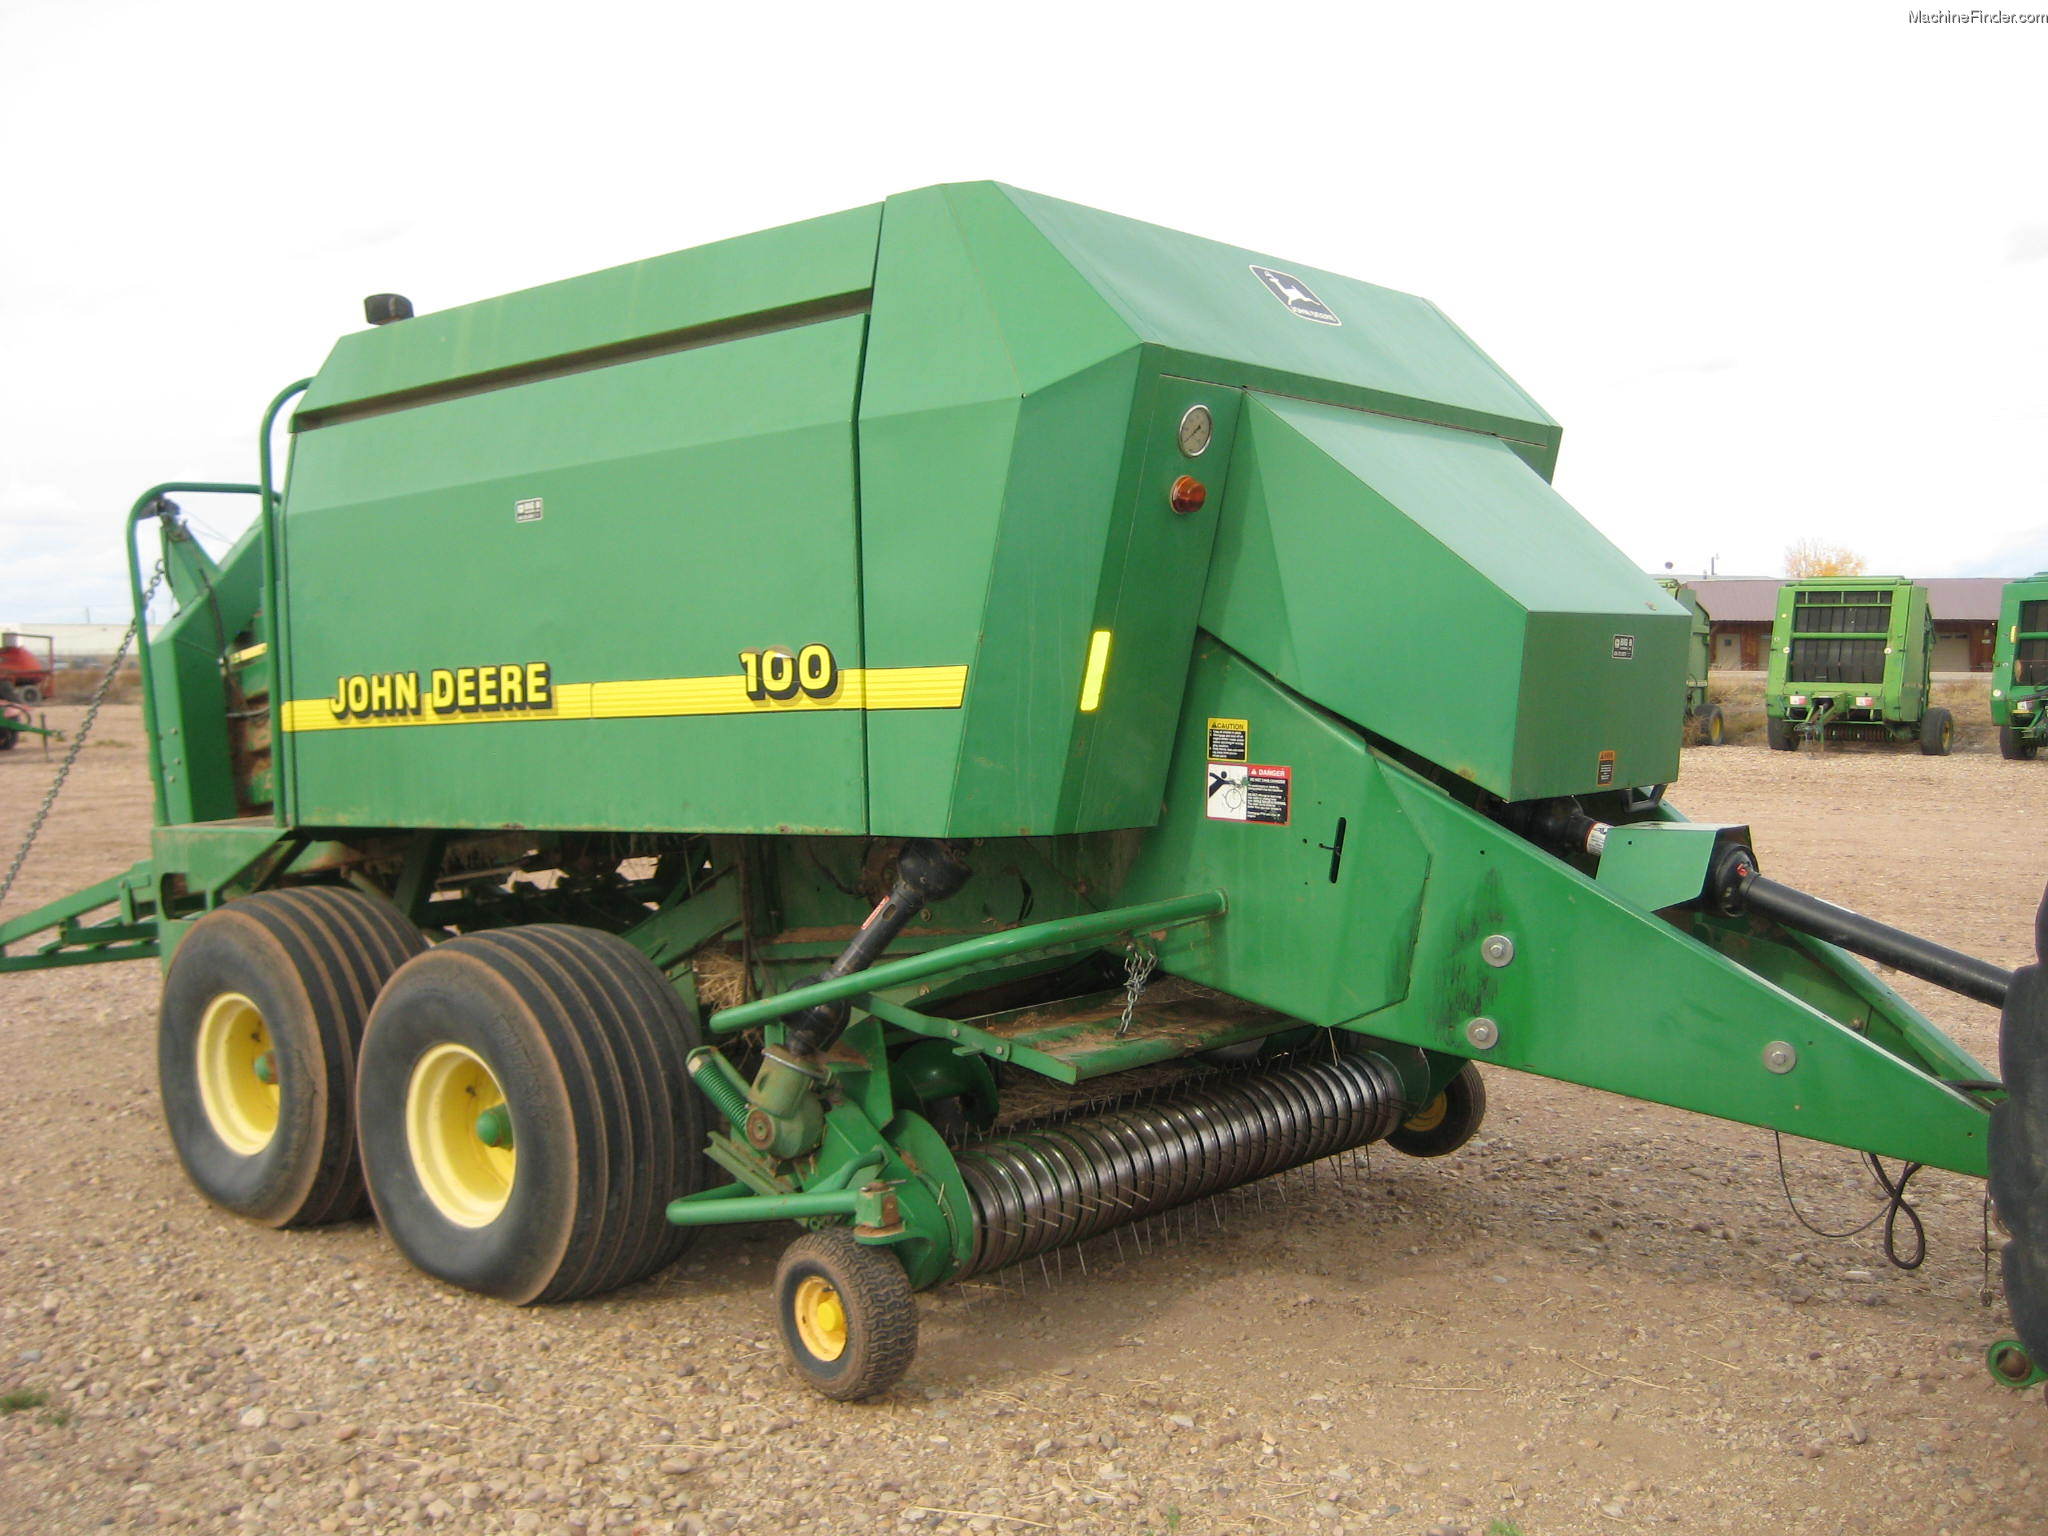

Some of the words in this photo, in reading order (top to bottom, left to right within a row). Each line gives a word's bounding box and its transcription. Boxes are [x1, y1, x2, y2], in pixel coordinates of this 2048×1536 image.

[329, 671, 422, 718] JOHN
[431, 661, 552, 714] DEERE
[738, 643, 838, 701] 100
[1258, 768, 1285, 776] DANGER
